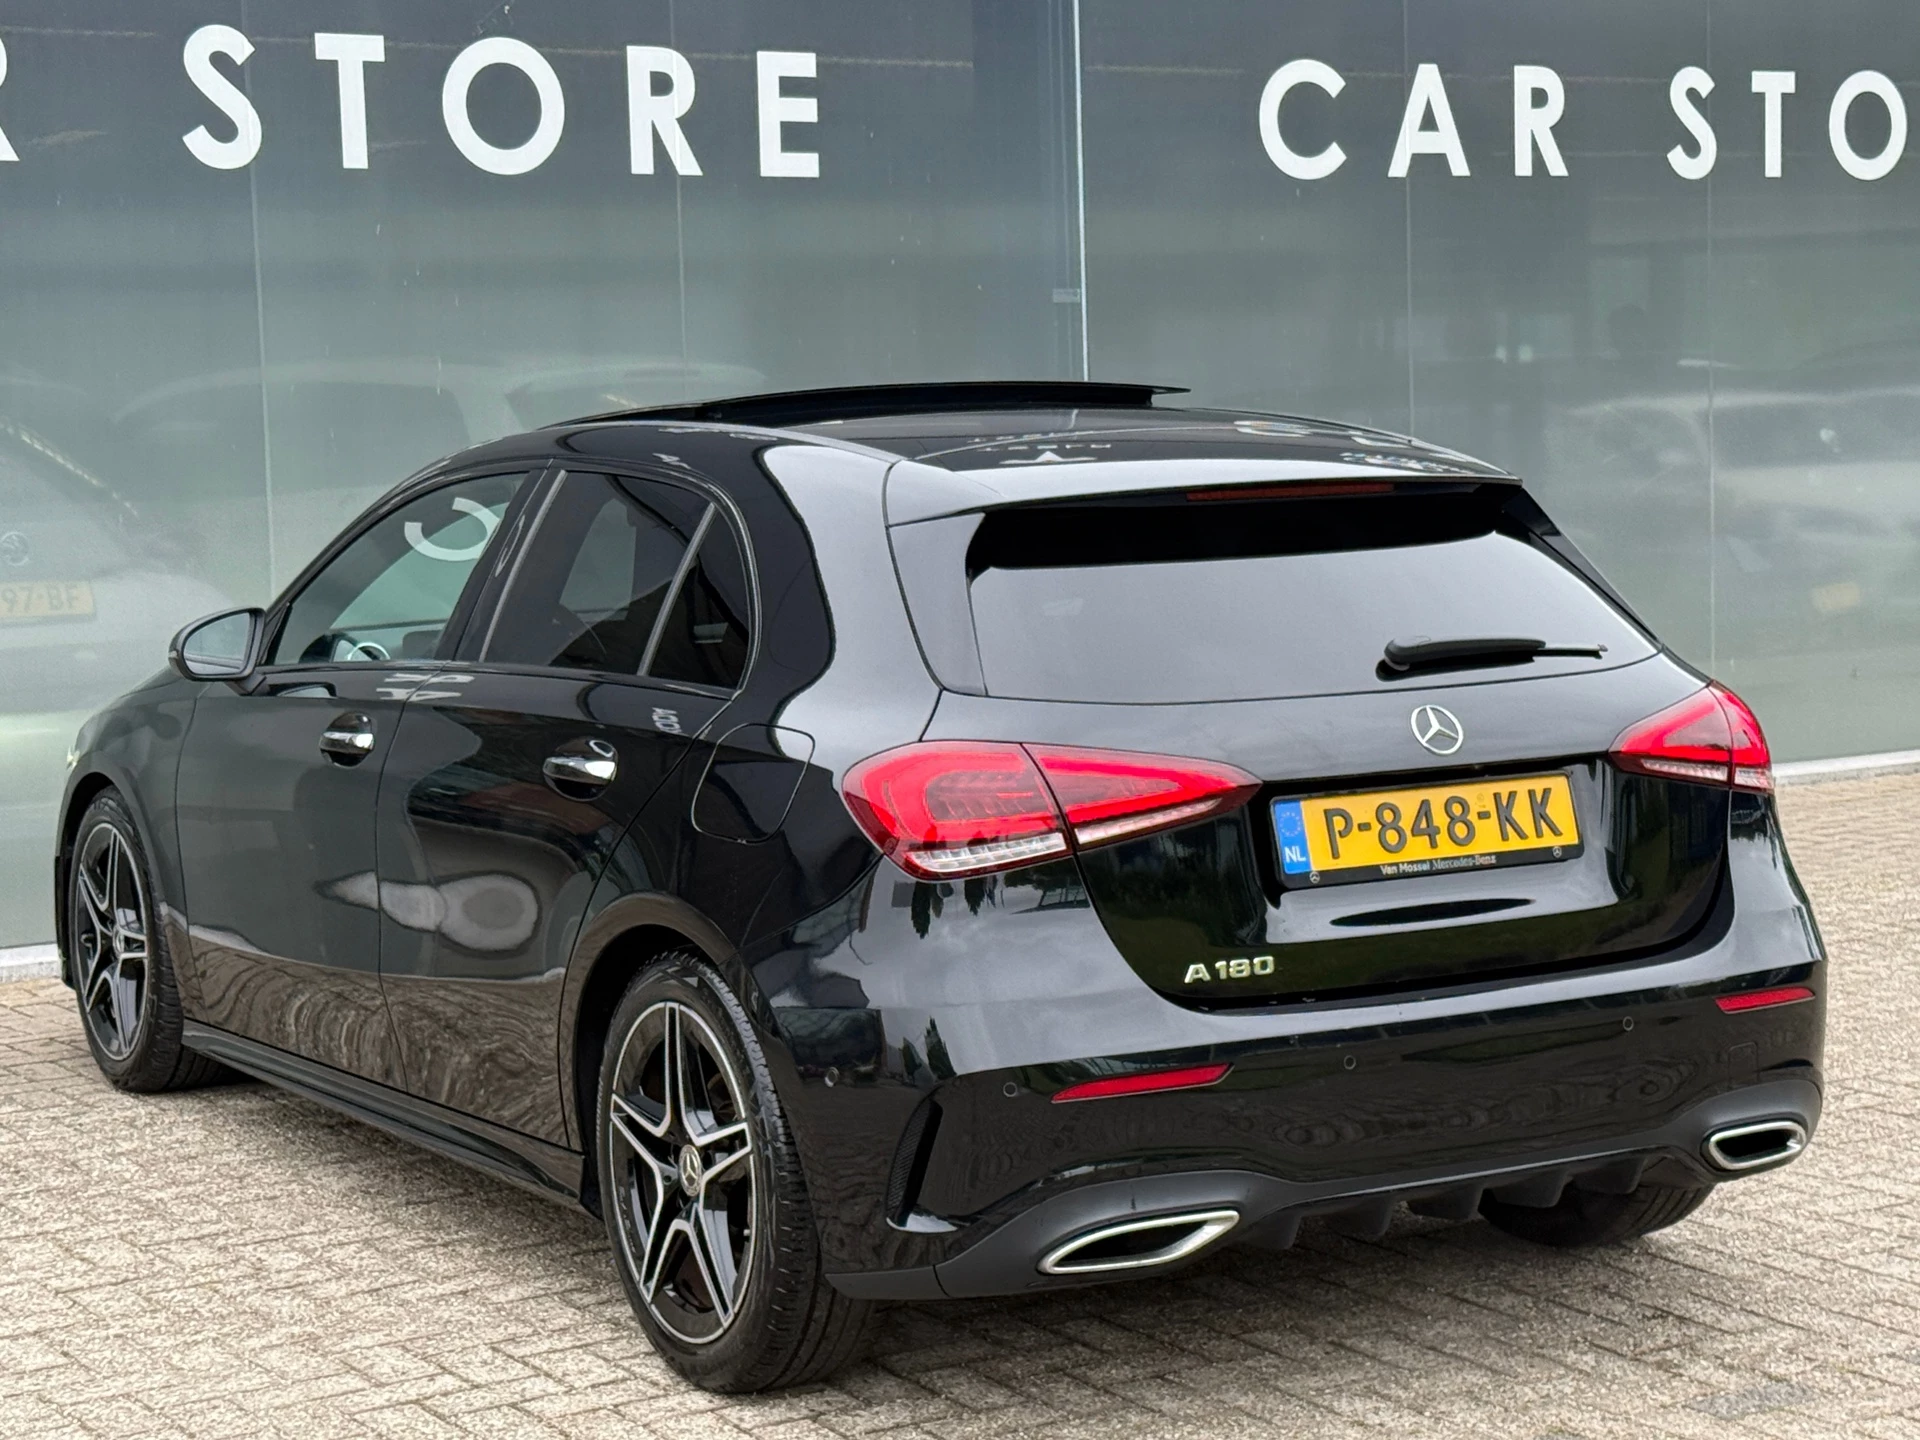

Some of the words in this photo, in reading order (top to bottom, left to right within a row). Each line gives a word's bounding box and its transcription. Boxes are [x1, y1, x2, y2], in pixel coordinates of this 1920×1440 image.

[183, 24, 821, 178] STORE
[1258, 58, 1570, 180] CAR
[1666, 65, 1908, 181] STO
[1322, 787, 1564, 860] P-848-KK
[1285, 845, 1306, 863] NL
[1380, 864, 1398, 876] Van
[1399, 860, 1431, 875] Mossel
[1432, 854, 1497, 871] Mercedes-Benz
[1184, 963, 1211, 983] A
[1215, 956, 1275, 980] 180
